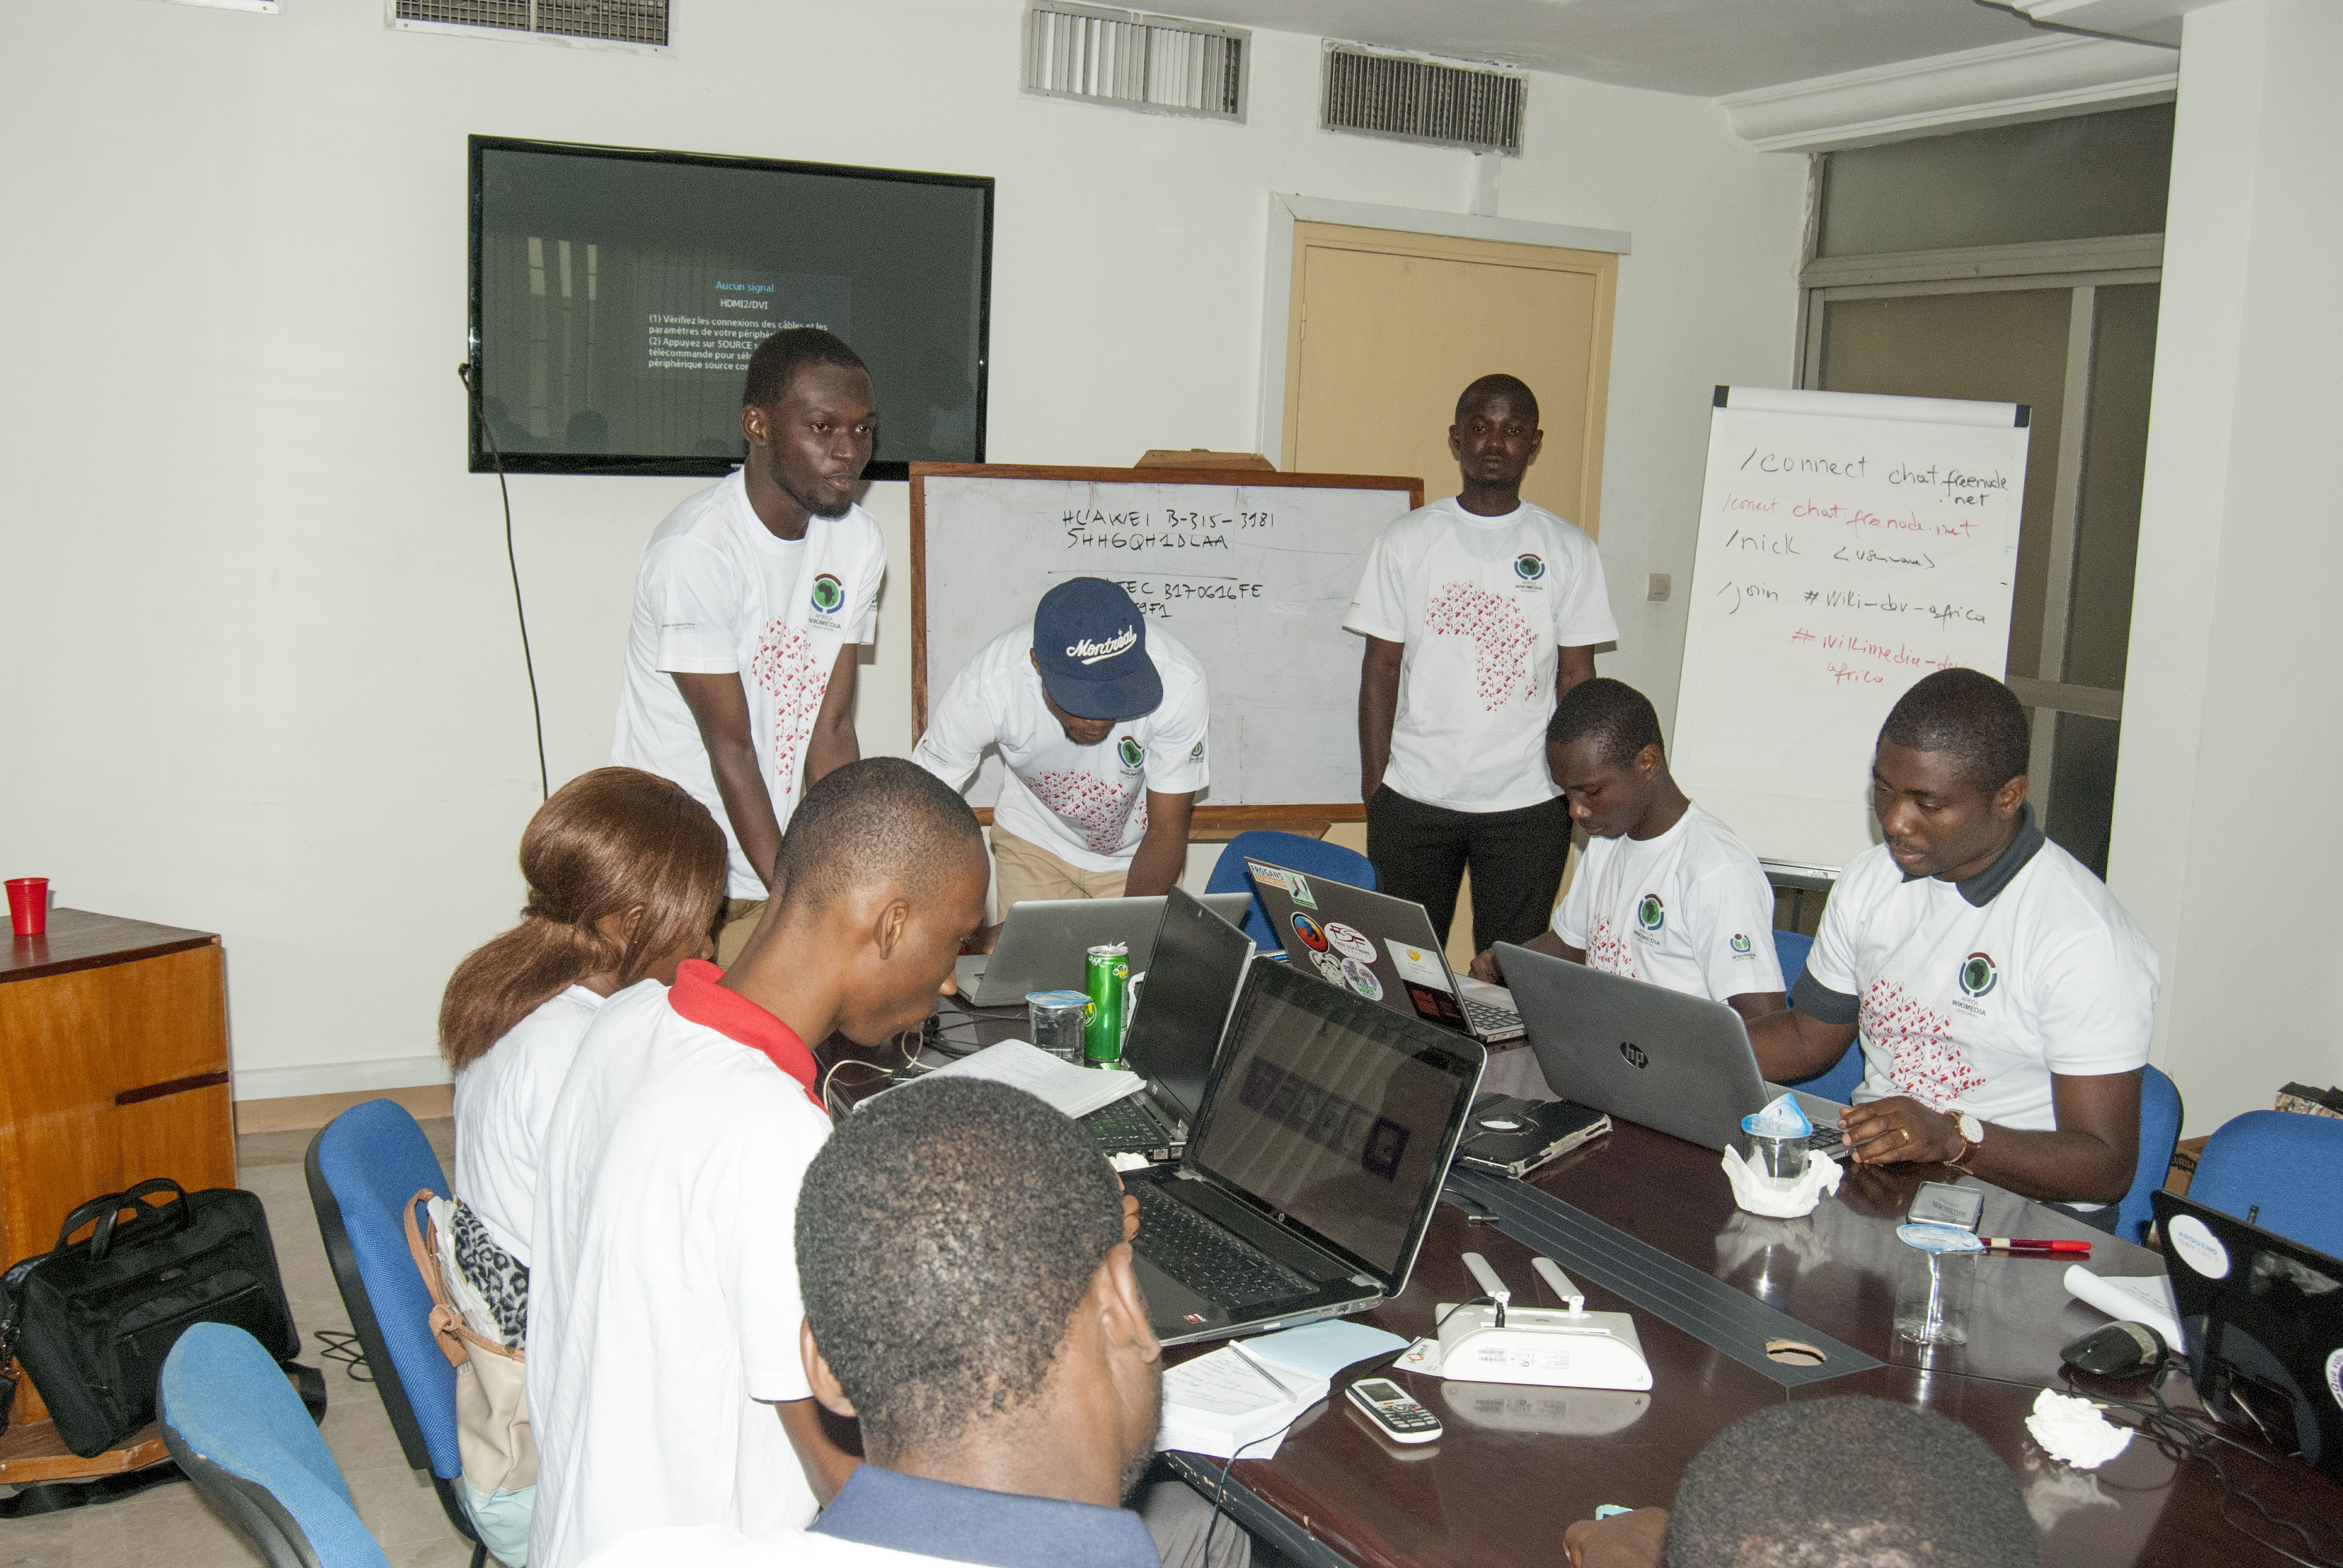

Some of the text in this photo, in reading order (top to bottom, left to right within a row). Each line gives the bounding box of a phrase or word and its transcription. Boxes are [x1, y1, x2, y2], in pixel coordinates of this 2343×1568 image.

[716, 281, 774, 294] Aucun signal
[720, 299, 768, 309] HDMI2/DVI
[649, 315, 661, 323] (1)
[663, 315, 696, 324] Vérifiez
[698, 317, 709, 325] les
[712, 318, 759, 328] connexions
[761, 320, 776, 328] des
[649, 326, 699, 336] paramètres
[701, 328, 712, 336] de
[649, 338, 661, 346] (2)
[663, 338, 700, 349] Appuyez
[649, 349, 713, 359] télécommande
[649, 359, 702, 370] périphérique
[1741, 447, 1869, 478] /connect
[1062, 509, 1150, 527] HUAWEI
[1726, 529, 1800, 555] /nick
[1717, 581, 1778, 614] /join
[1250, 865, 1283, 880] FROGANS
[1951, 999, 1986, 1016] WIKIMEDIA
